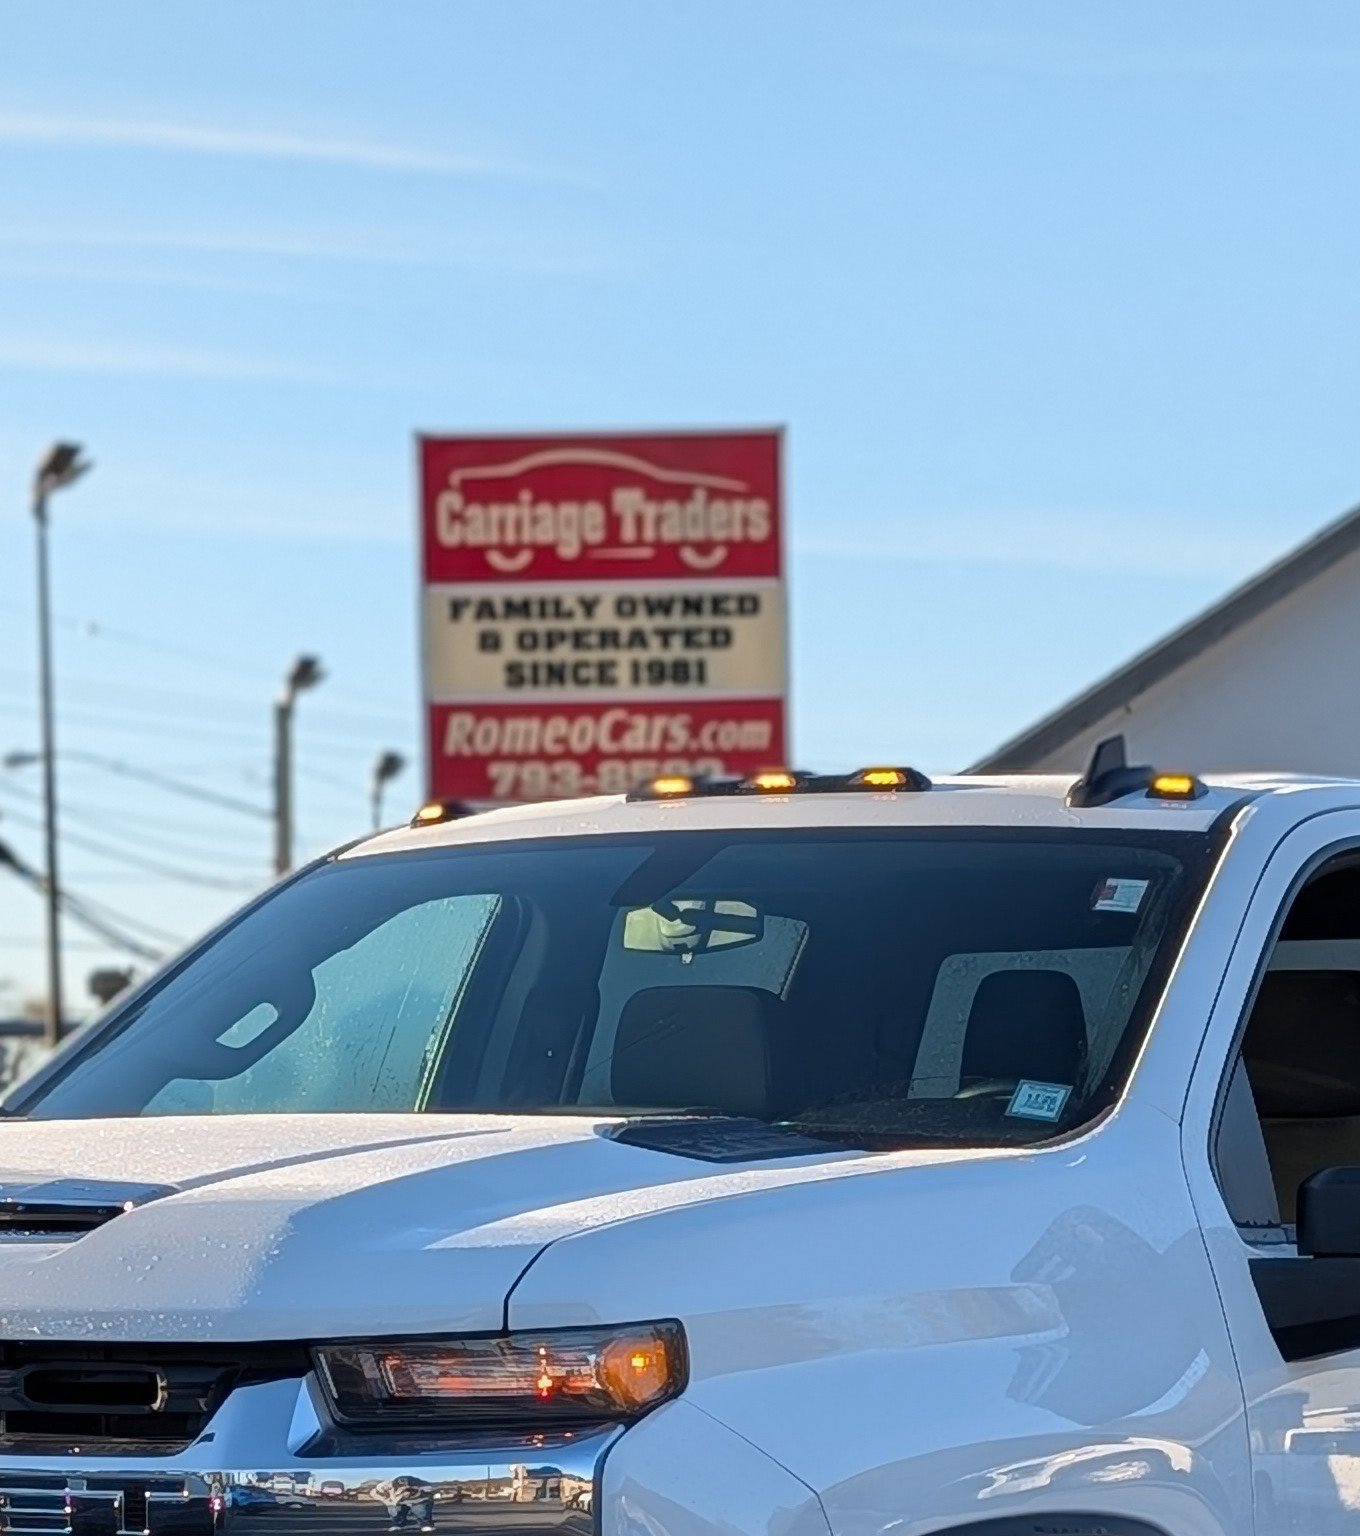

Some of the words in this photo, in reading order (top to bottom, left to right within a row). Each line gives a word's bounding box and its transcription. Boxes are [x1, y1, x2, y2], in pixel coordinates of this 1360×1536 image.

[437, 490, 606, 560] Carriage
[612, 485, 770, 543] Traders
[449, 594, 602, 622] FAMILY
[614, 593, 761, 617] OWNED
[516, 626, 733, 653] OPERATED
[505, 660, 618, 688] SINCE
[630, 657, 707, 686] 1981
[444, 709, 773, 757] RomeoCars.com
